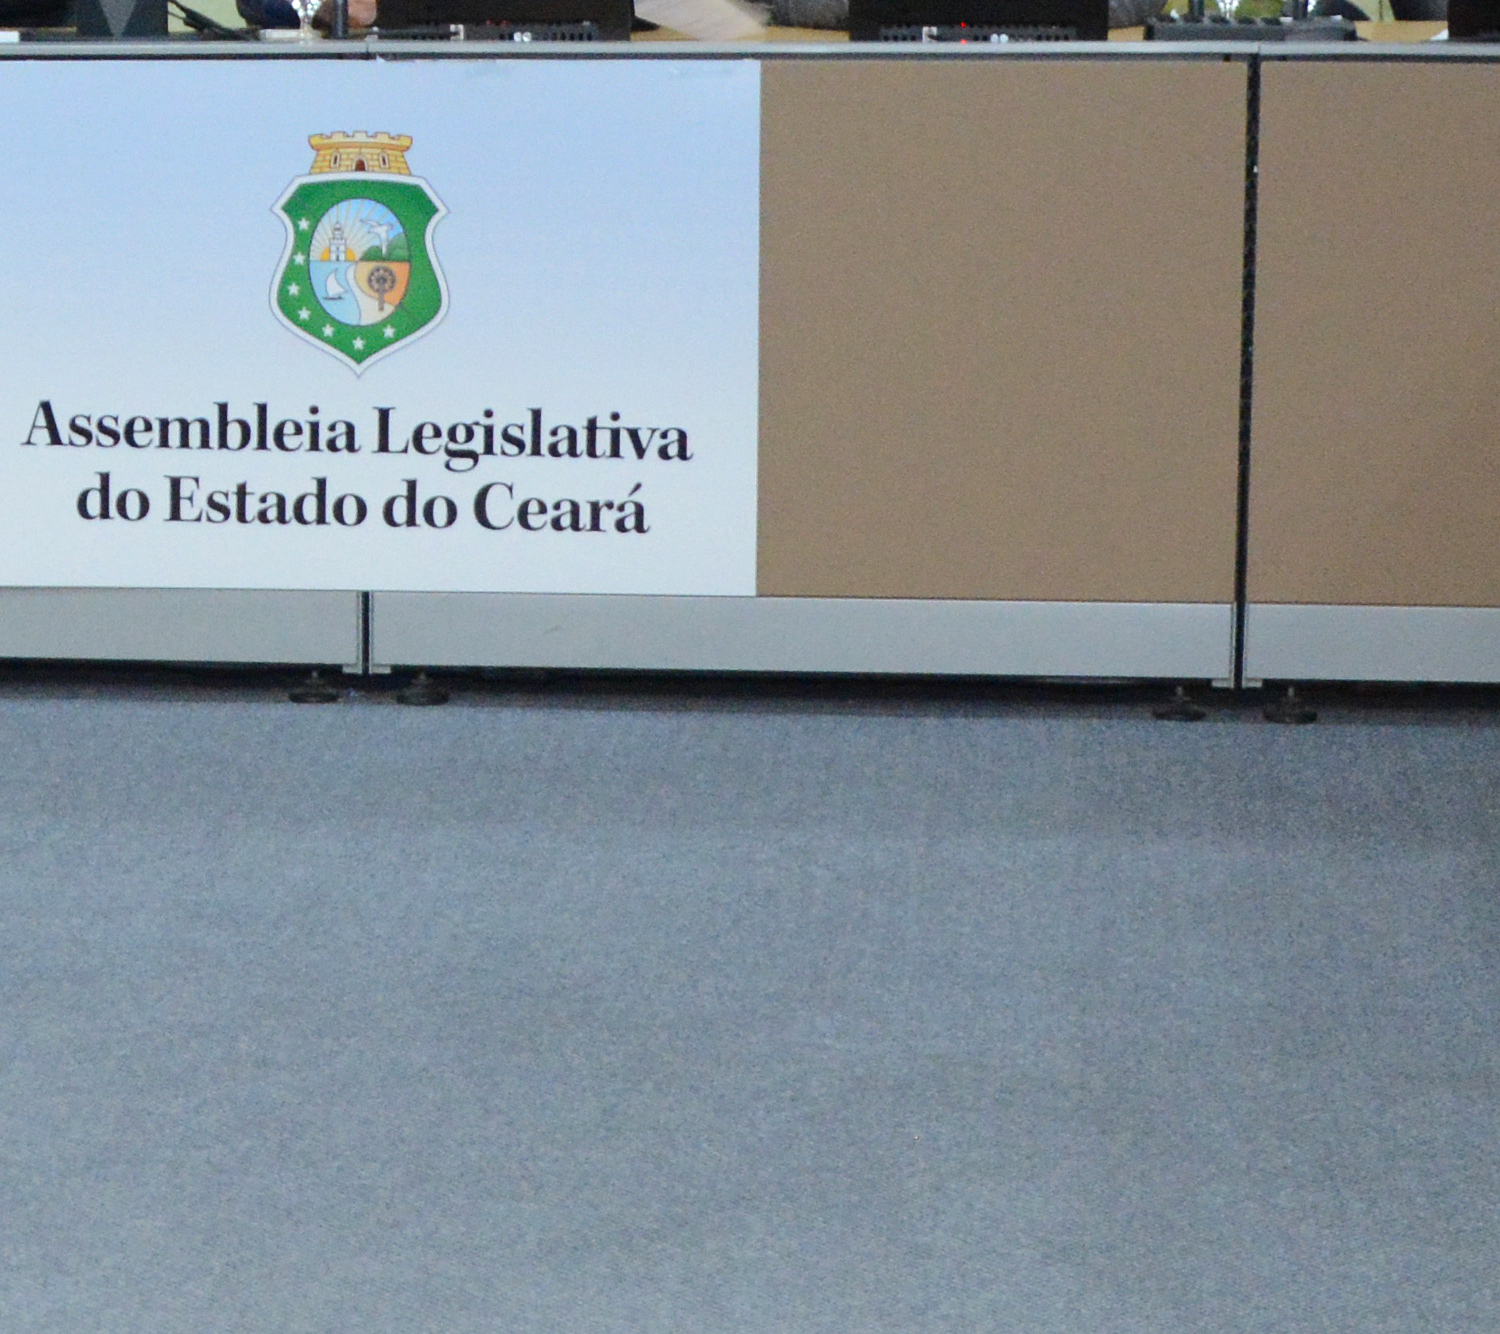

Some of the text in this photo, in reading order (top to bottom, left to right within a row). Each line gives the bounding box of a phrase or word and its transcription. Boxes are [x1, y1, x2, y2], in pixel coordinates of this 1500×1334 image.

[21, 400, 694, 473] Assembleia Legislativa
[75, 471, 650, 535] do Estado do Ceará
